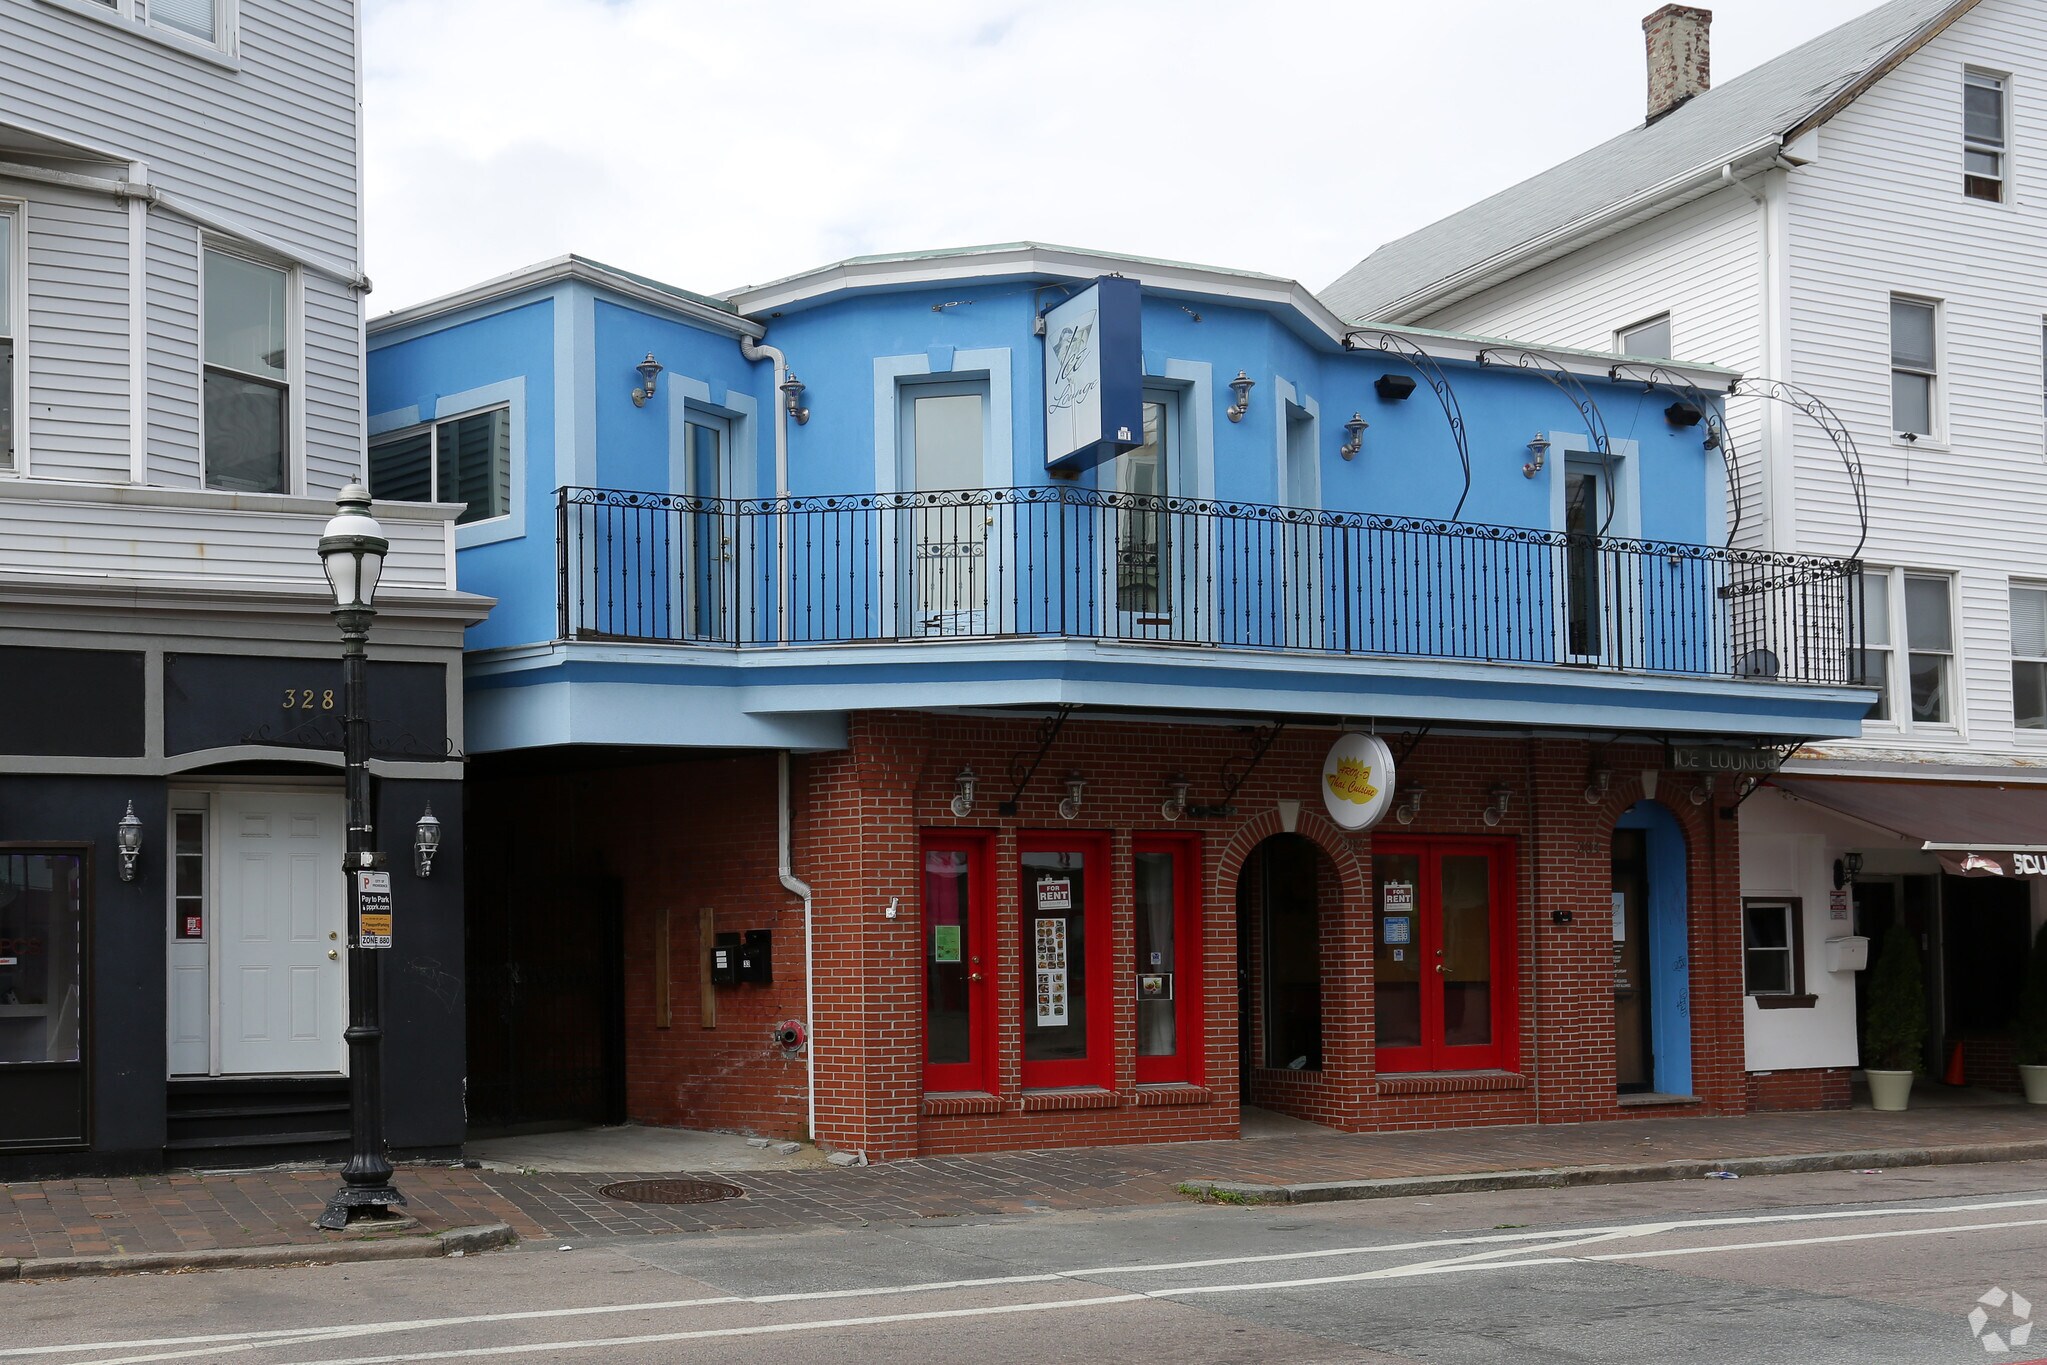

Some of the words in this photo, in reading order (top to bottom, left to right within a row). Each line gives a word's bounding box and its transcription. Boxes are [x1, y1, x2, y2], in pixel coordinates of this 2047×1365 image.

[1048, 379, 1099, 414] Lounge
[282, 689, 334, 711] 328
[1329, 775, 1345, 789] Thai
[1348, 780, 1375, 797] Cuisine
[362, 895, 371, 904] Pay
[1040, 891, 1068, 900] RENT
[1386, 895, 1411, 903] RENT
[363, 936, 378, 944] ZONE
[379, 936, 390, 944] 880
